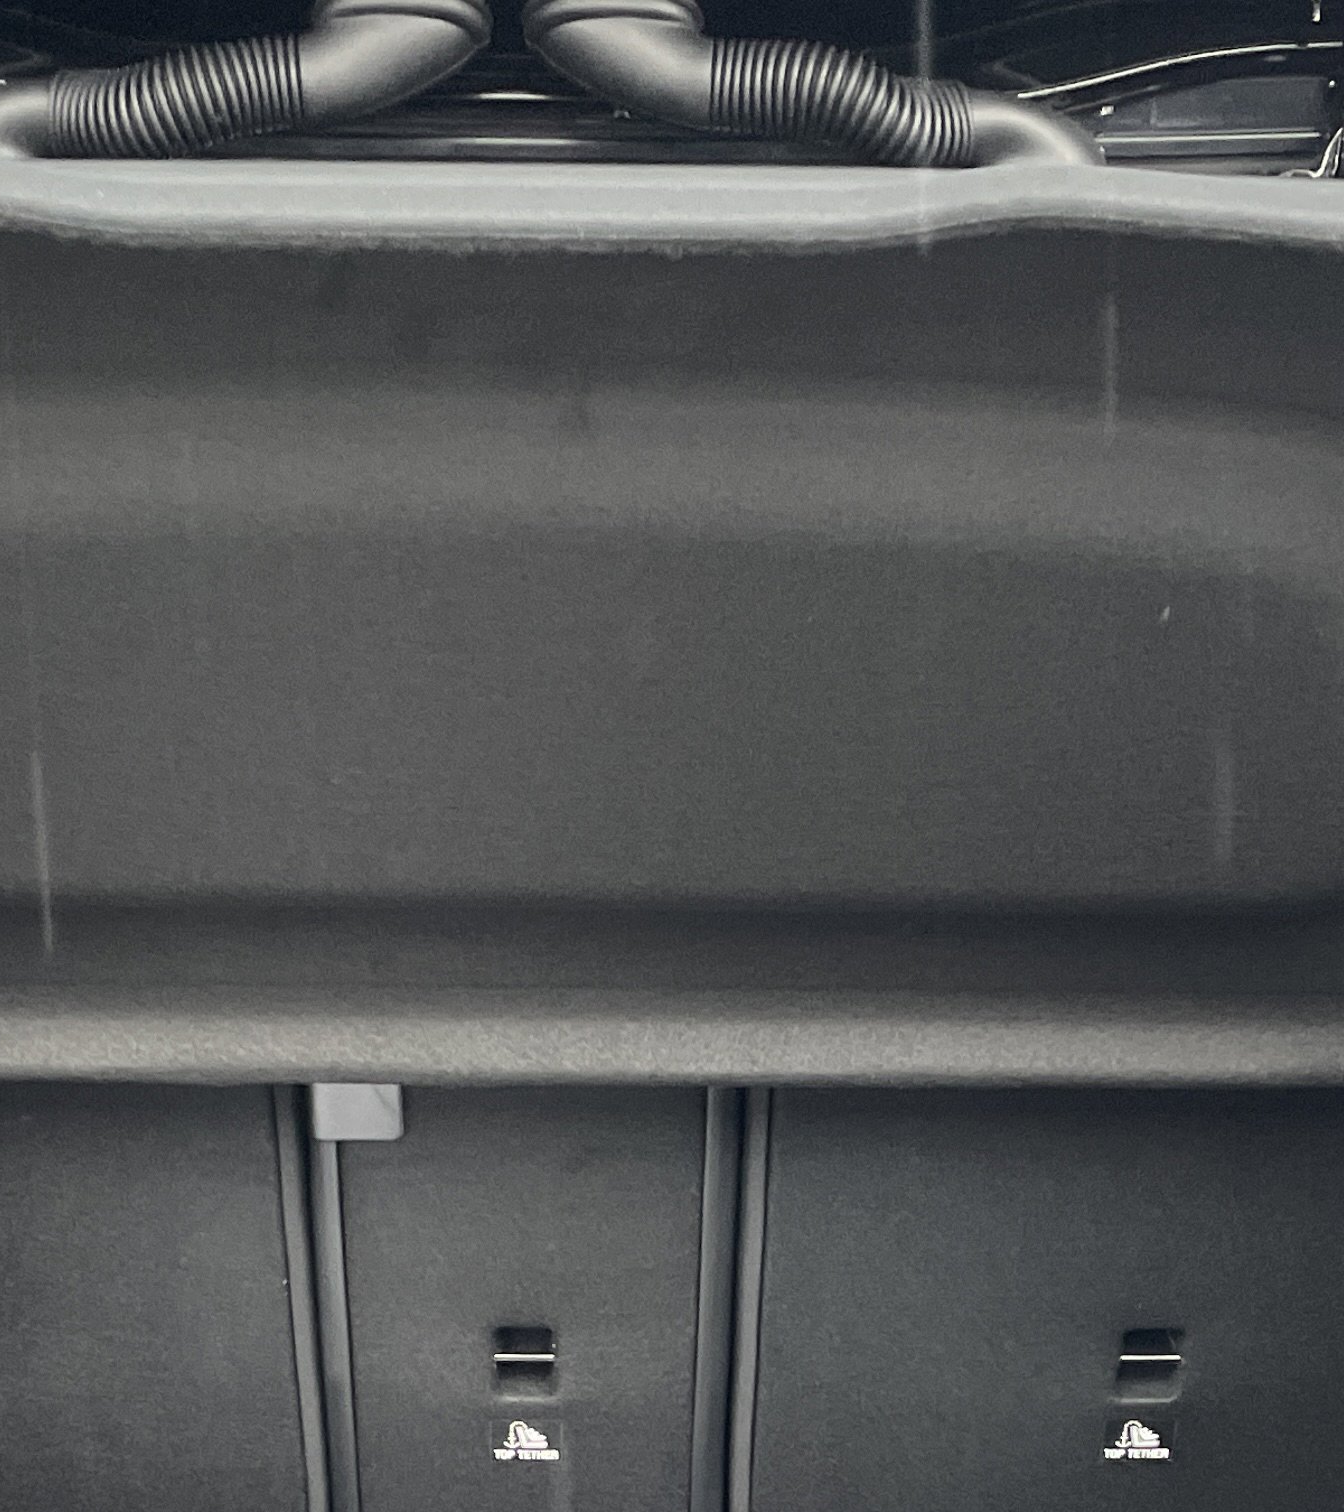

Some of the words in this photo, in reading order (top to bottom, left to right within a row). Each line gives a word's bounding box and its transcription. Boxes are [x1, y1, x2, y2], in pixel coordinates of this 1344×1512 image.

[493, 1449, 516, 1460] TOP
[1104, 1448, 1126, 1458] TOP
[1128, 1448, 1169, 1458] TETHER
